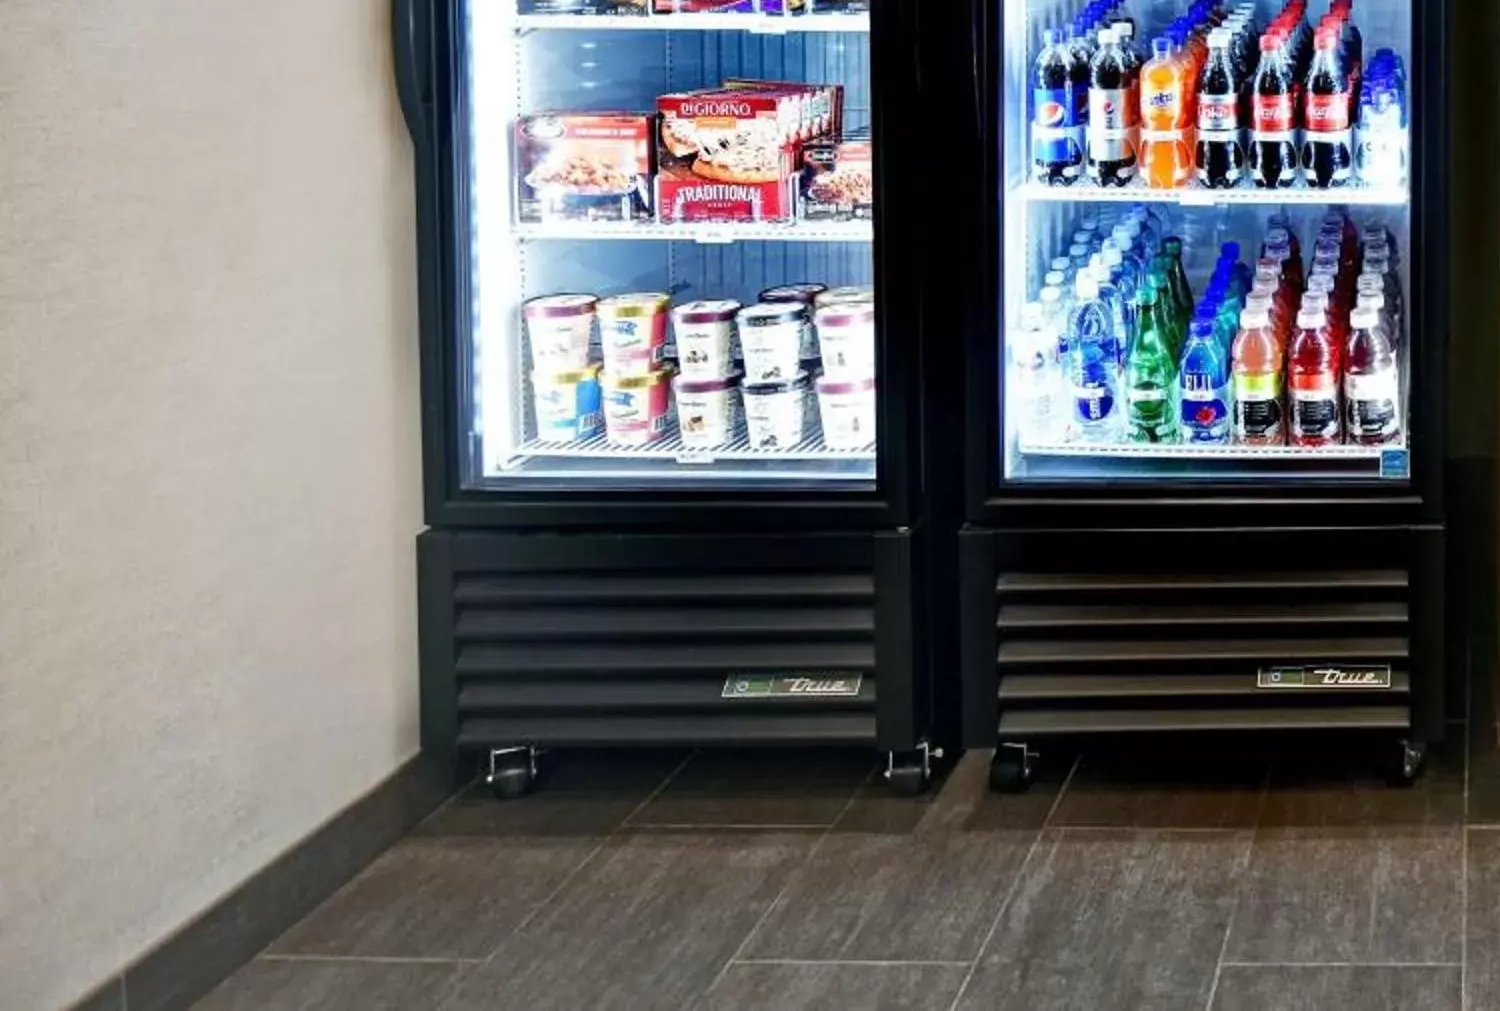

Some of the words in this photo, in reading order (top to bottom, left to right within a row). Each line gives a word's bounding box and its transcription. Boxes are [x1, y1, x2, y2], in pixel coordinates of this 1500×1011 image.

[676, 186, 762, 204] TRADITIONAL
[1186, 374, 1213, 391] FIJI
[1313, 669, 1383, 683] True
[784, 678, 850, 692] True
